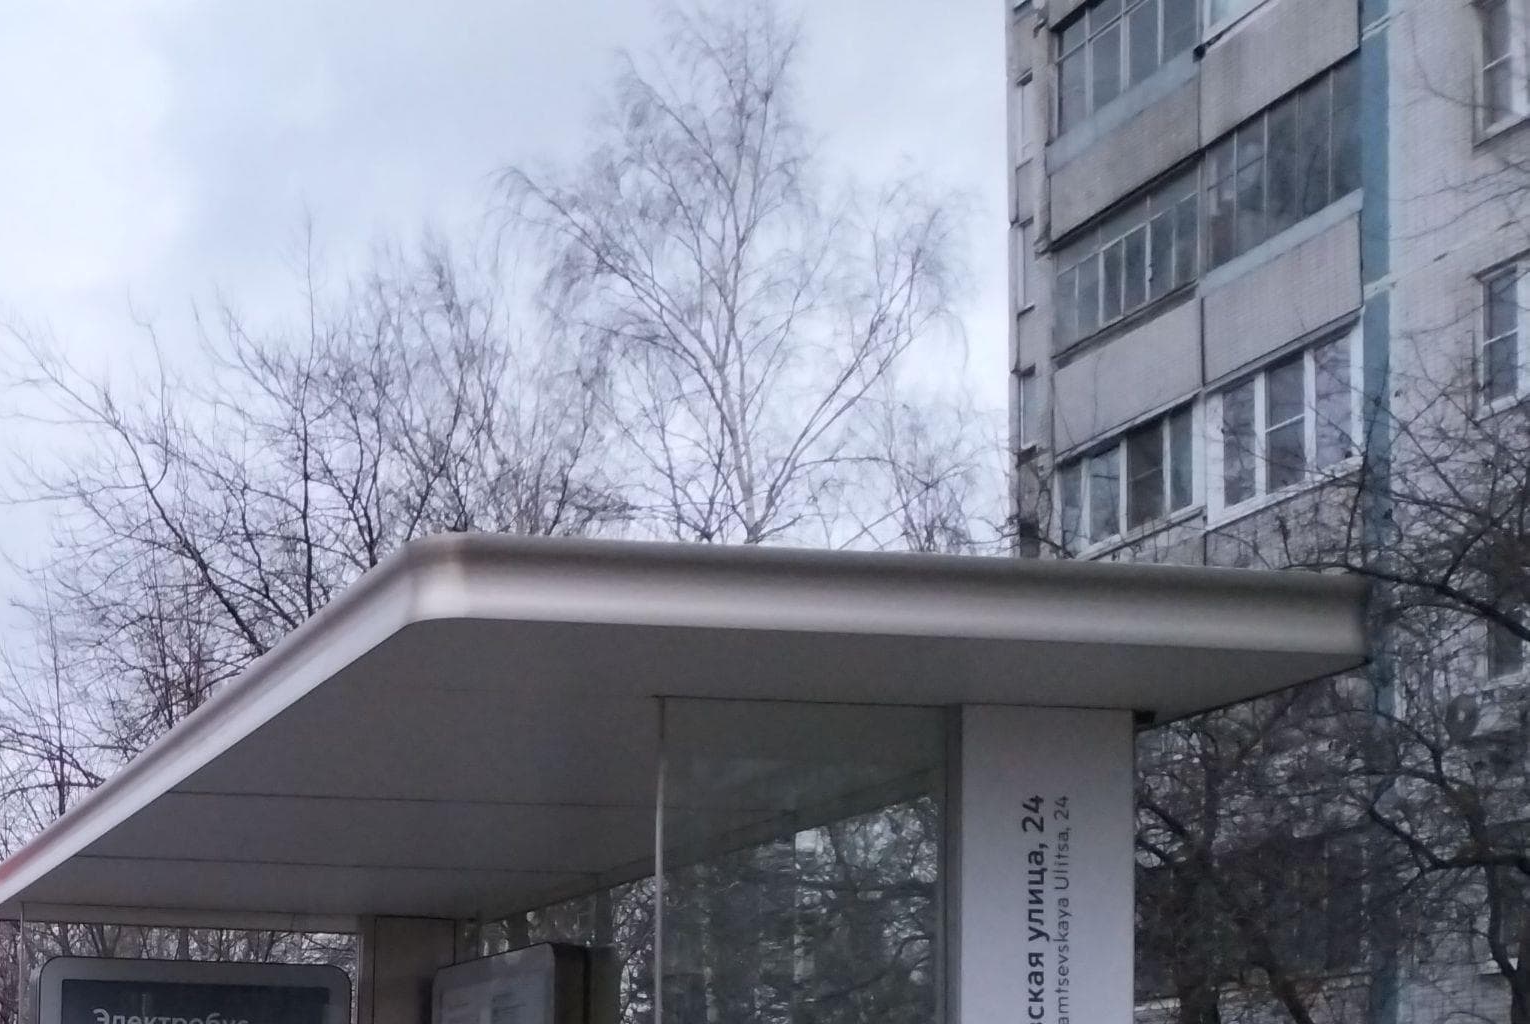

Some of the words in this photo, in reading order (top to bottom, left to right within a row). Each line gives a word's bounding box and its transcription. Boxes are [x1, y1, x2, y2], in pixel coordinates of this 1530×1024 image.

[1022, 795, 1044, 832] 24
[1054, 796, 1069, 820] 24
[1053, 827, 1072, 890] Ulitsa,
[1027, 843, 1050, 943] улица,
